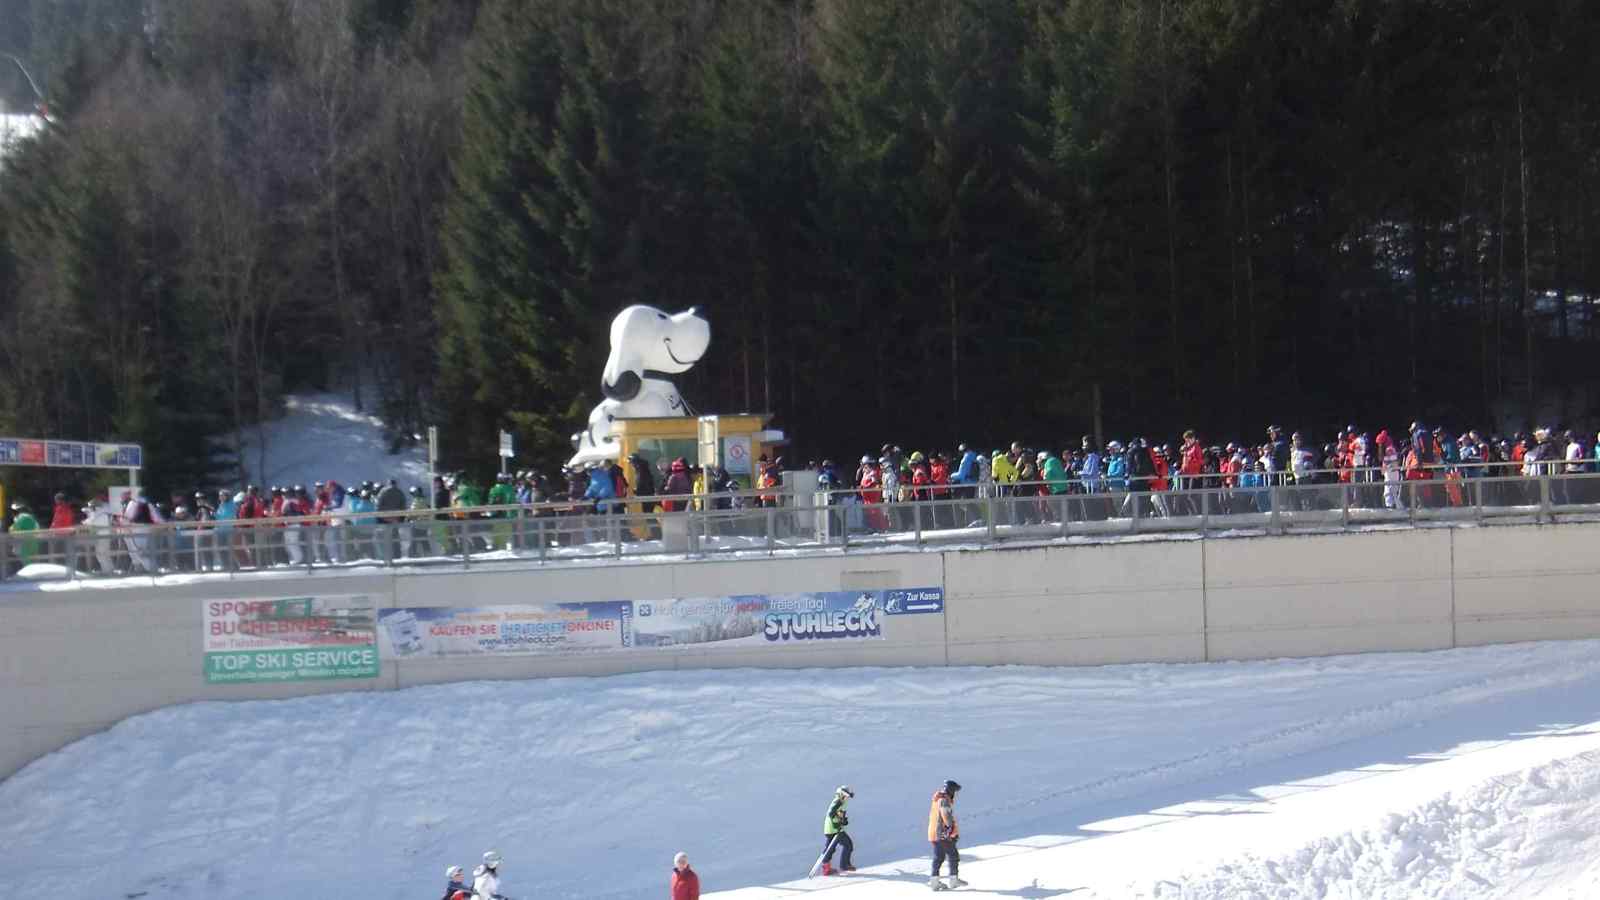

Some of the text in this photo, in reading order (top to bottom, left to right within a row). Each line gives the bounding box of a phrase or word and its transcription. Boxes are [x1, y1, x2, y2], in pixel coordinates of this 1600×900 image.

[906, 592, 918, 601] Zur
[480, 623, 497, 635] SIE
[765, 608, 878, 638] STUHLECK
[211, 649, 375, 671] TOP SKI SERVICE
